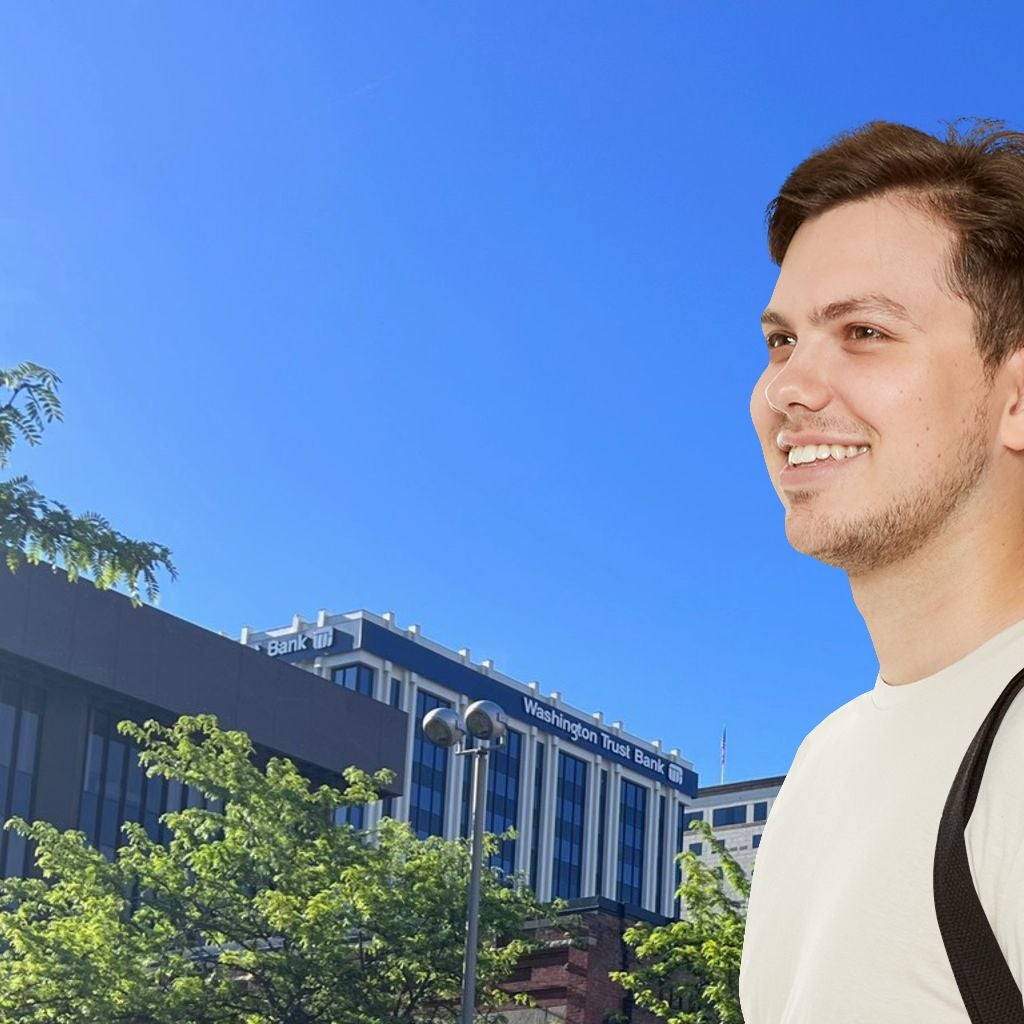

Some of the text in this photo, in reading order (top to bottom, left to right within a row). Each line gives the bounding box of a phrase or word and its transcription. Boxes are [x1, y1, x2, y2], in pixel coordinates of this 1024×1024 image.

[267, 634, 308, 657] Bank
[523, 697, 665, 775] Washington Trust Bank
